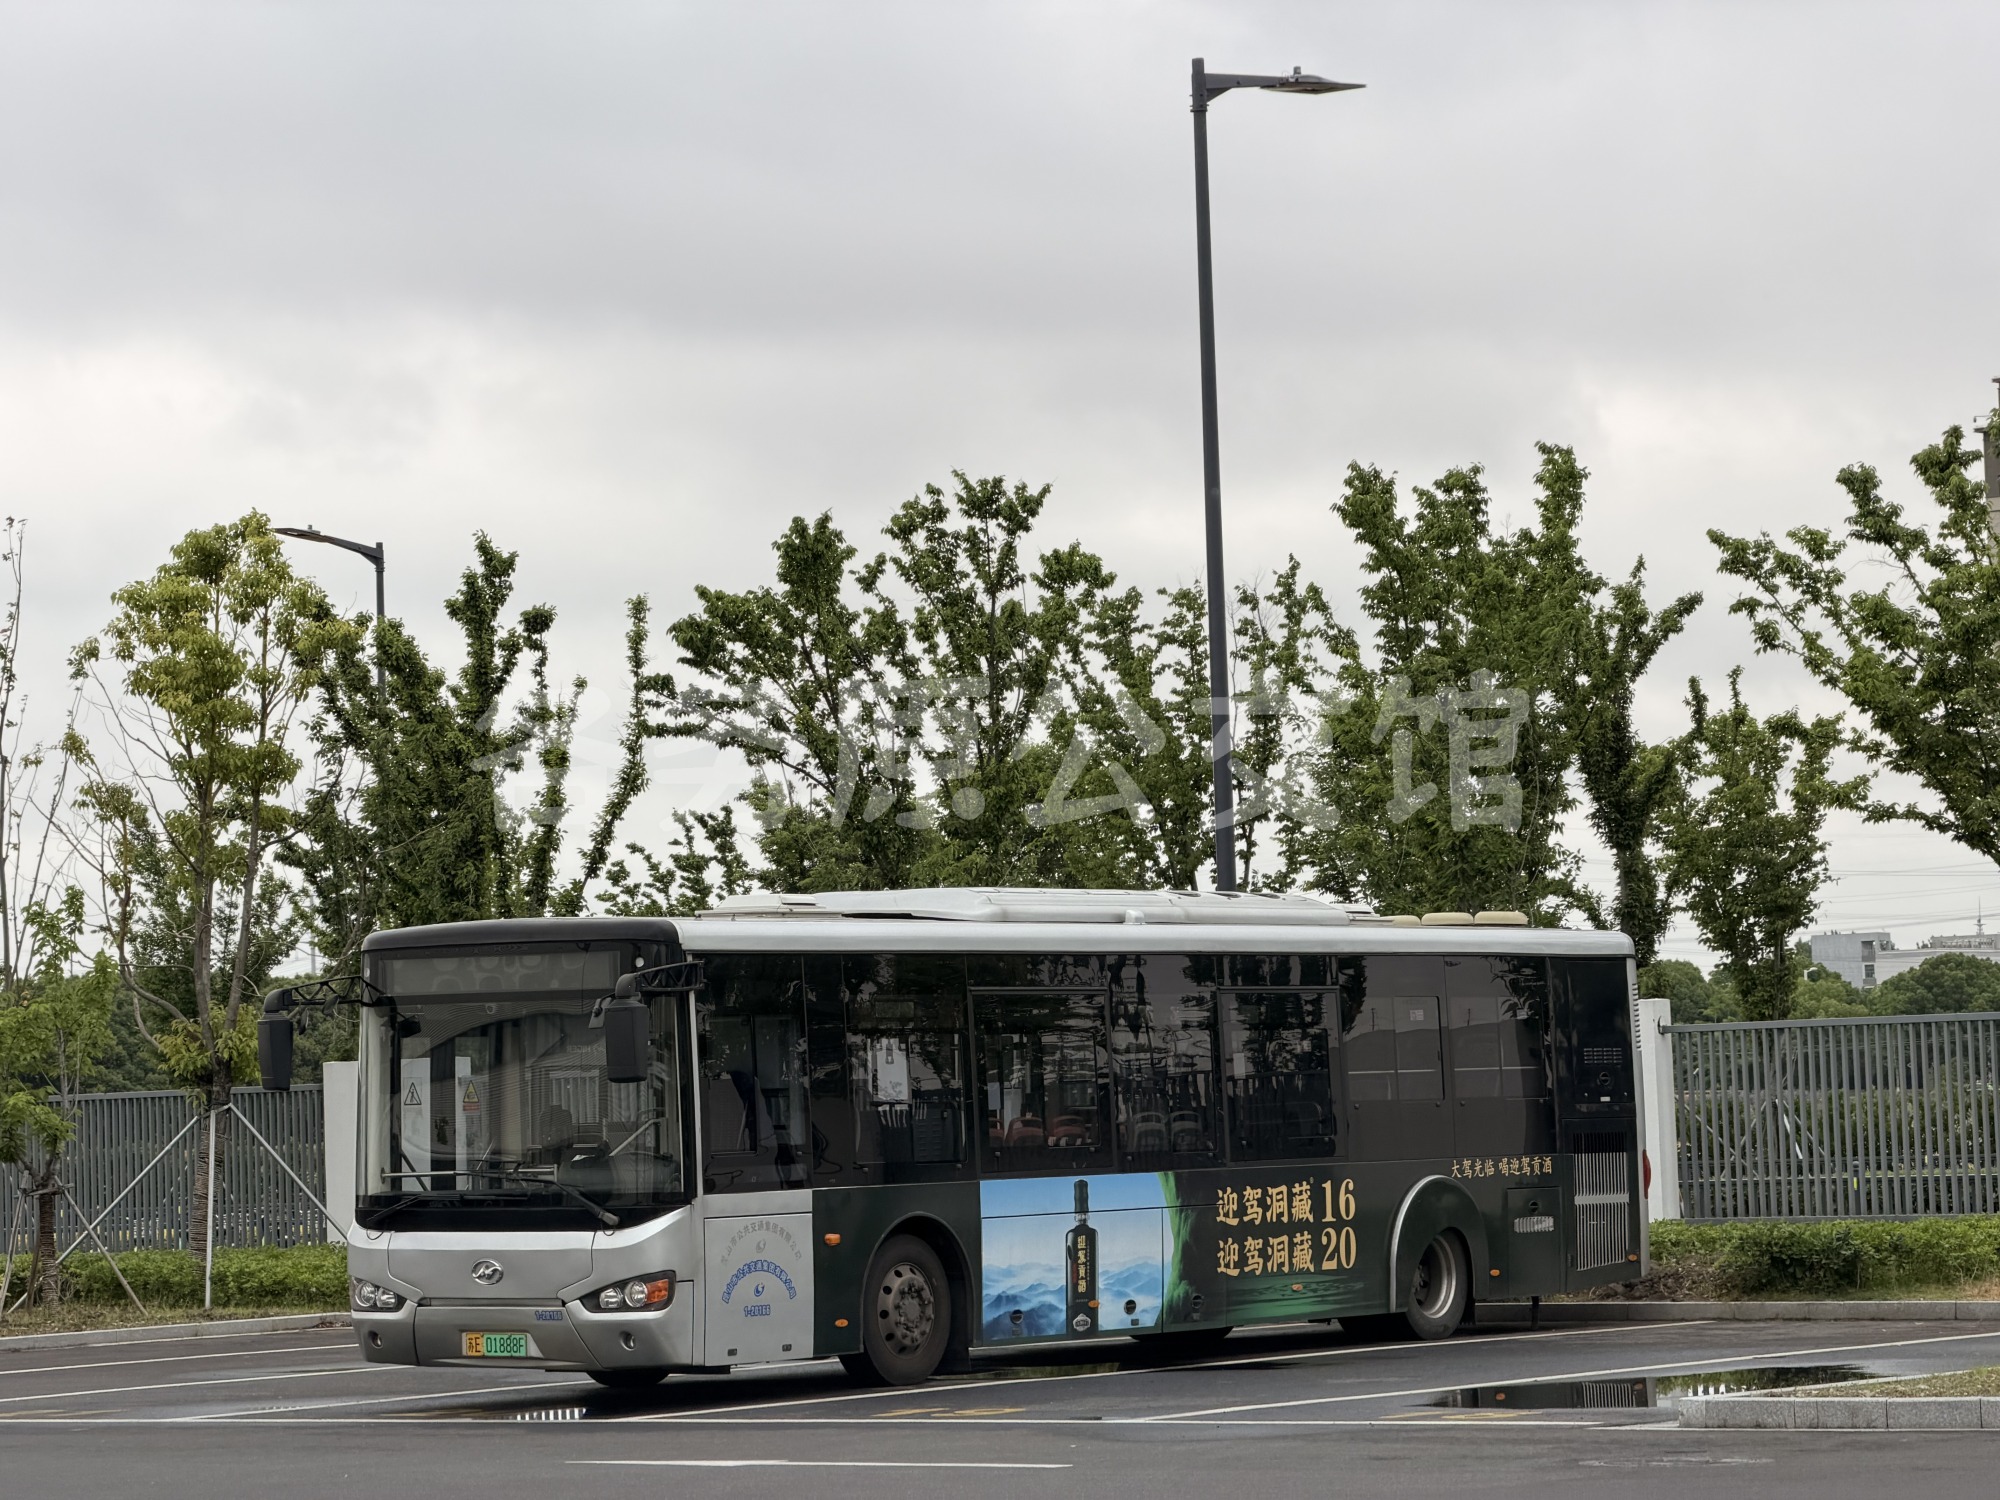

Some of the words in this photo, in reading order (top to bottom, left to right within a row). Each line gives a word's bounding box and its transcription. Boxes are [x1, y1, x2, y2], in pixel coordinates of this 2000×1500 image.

[1451, 1158, 1495, 1179] 大驾光临
[1498, 1156, 1553, 1177] 喝迎驾贡酒
[1215, 1180, 1314, 1226] 迎驾洞藏
[1321, 1178, 1356, 1222] 16
[1216, 1230, 1315, 1277] 迎驾洞藏
[1321, 1226, 1357, 1271] 20
